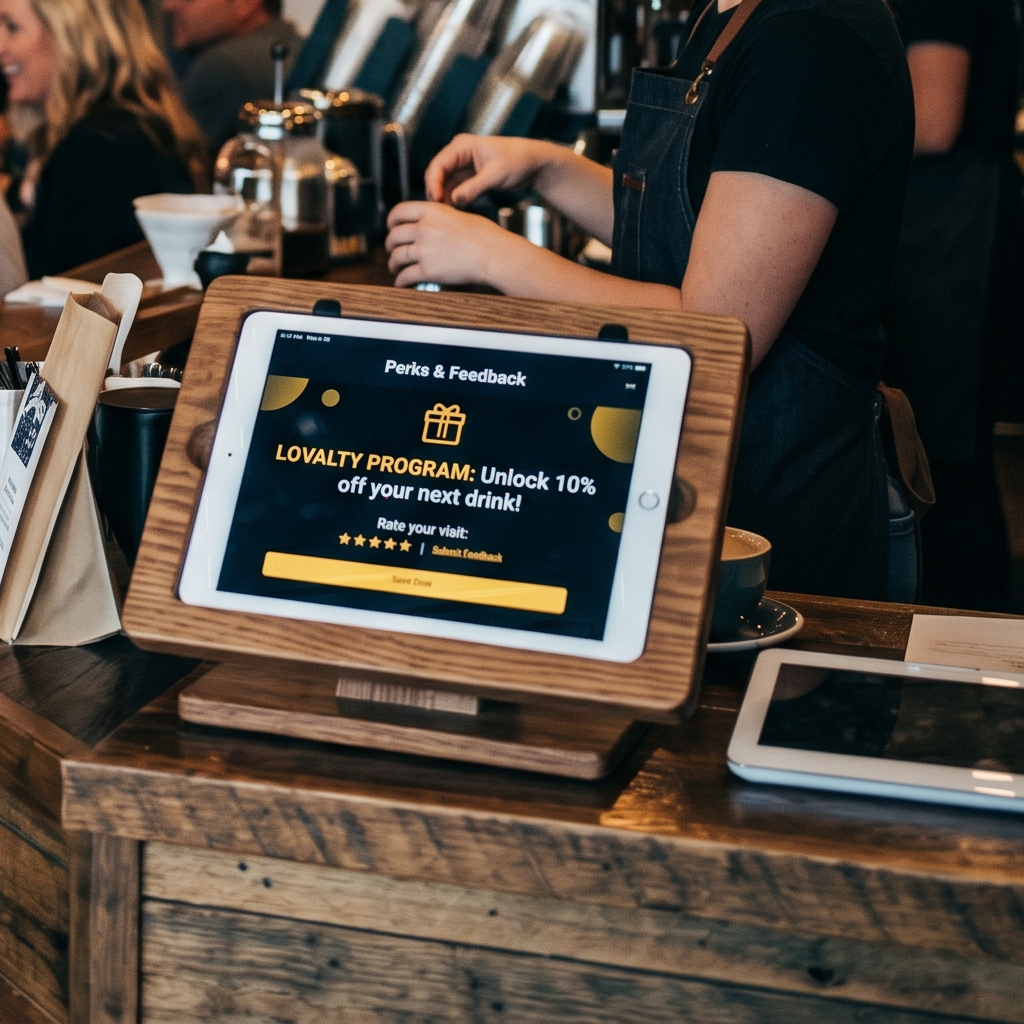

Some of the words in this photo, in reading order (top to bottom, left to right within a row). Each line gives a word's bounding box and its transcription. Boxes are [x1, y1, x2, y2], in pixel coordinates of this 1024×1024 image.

[384, 359, 430, 377] Perks
[433, 364, 446, 379] &
[448, 365, 527, 387] Feedback
[366, 453, 476, 482] PROGRAM:
[480, 465, 550, 491] Unlock
[555, 474, 597, 496] 10%
[337, 475, 368, 495] off
[368, 482, 414, 501] your
[417, 487, 462, 506] next
[464, 489, 523, 512] drink!
[376, 517, 407, 532] Rate
[407, 523, 437, 536] your
[438, 525, 469, 539] visit:
